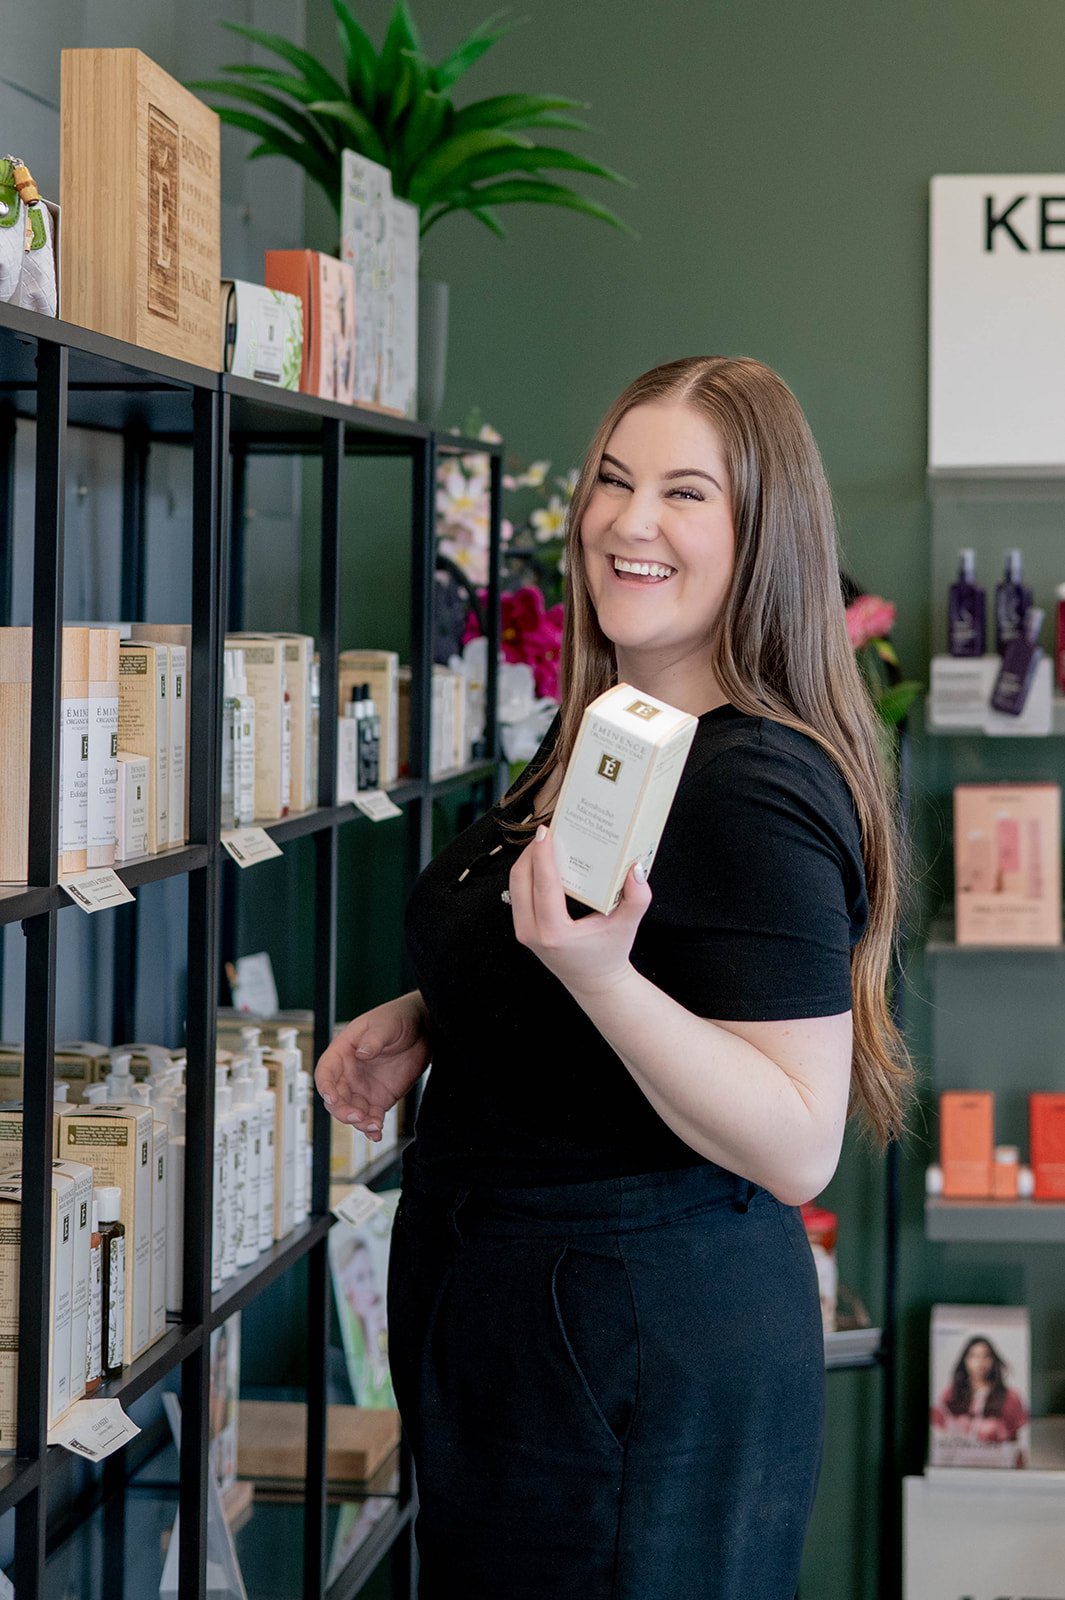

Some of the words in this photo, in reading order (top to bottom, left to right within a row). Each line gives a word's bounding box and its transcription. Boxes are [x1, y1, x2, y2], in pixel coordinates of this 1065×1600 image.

[985, 193, 1065, 252] KE
[592, 721, 647, 754] ÉMINENCE
[604, 759, 616, 777] É
